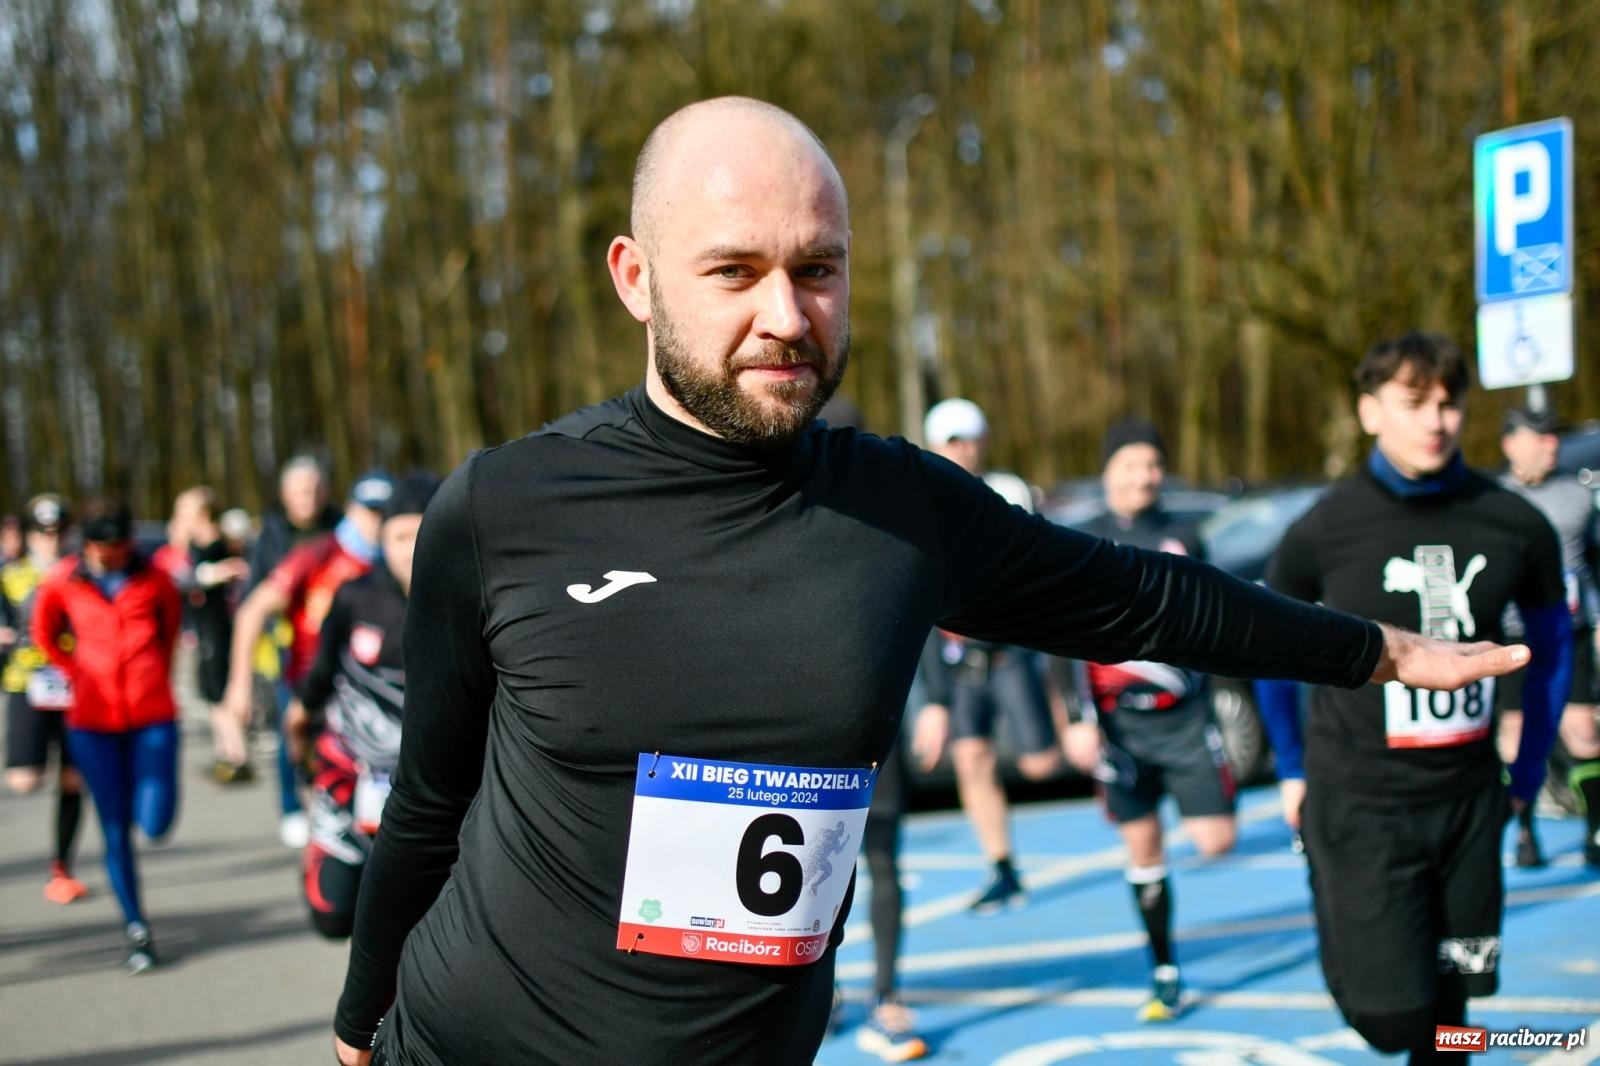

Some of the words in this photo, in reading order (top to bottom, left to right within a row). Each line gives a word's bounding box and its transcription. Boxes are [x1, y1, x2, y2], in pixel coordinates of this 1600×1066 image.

[1494, 140, 1551, 256] P
[1405, 682, 1483, 721] 108
[671, 762, 698, 780] XII
[702, 765, 749, 785] BIEG
[753, 769, 860, 790] TWARDZIELA
[728, 787, 744, 799] 25
[747, 788, 788, 805] lutego
[791, 791, 818, 804] 2024
[736, 813, 805, 917] 6
[705, 936, 781, 956] Racibórz
